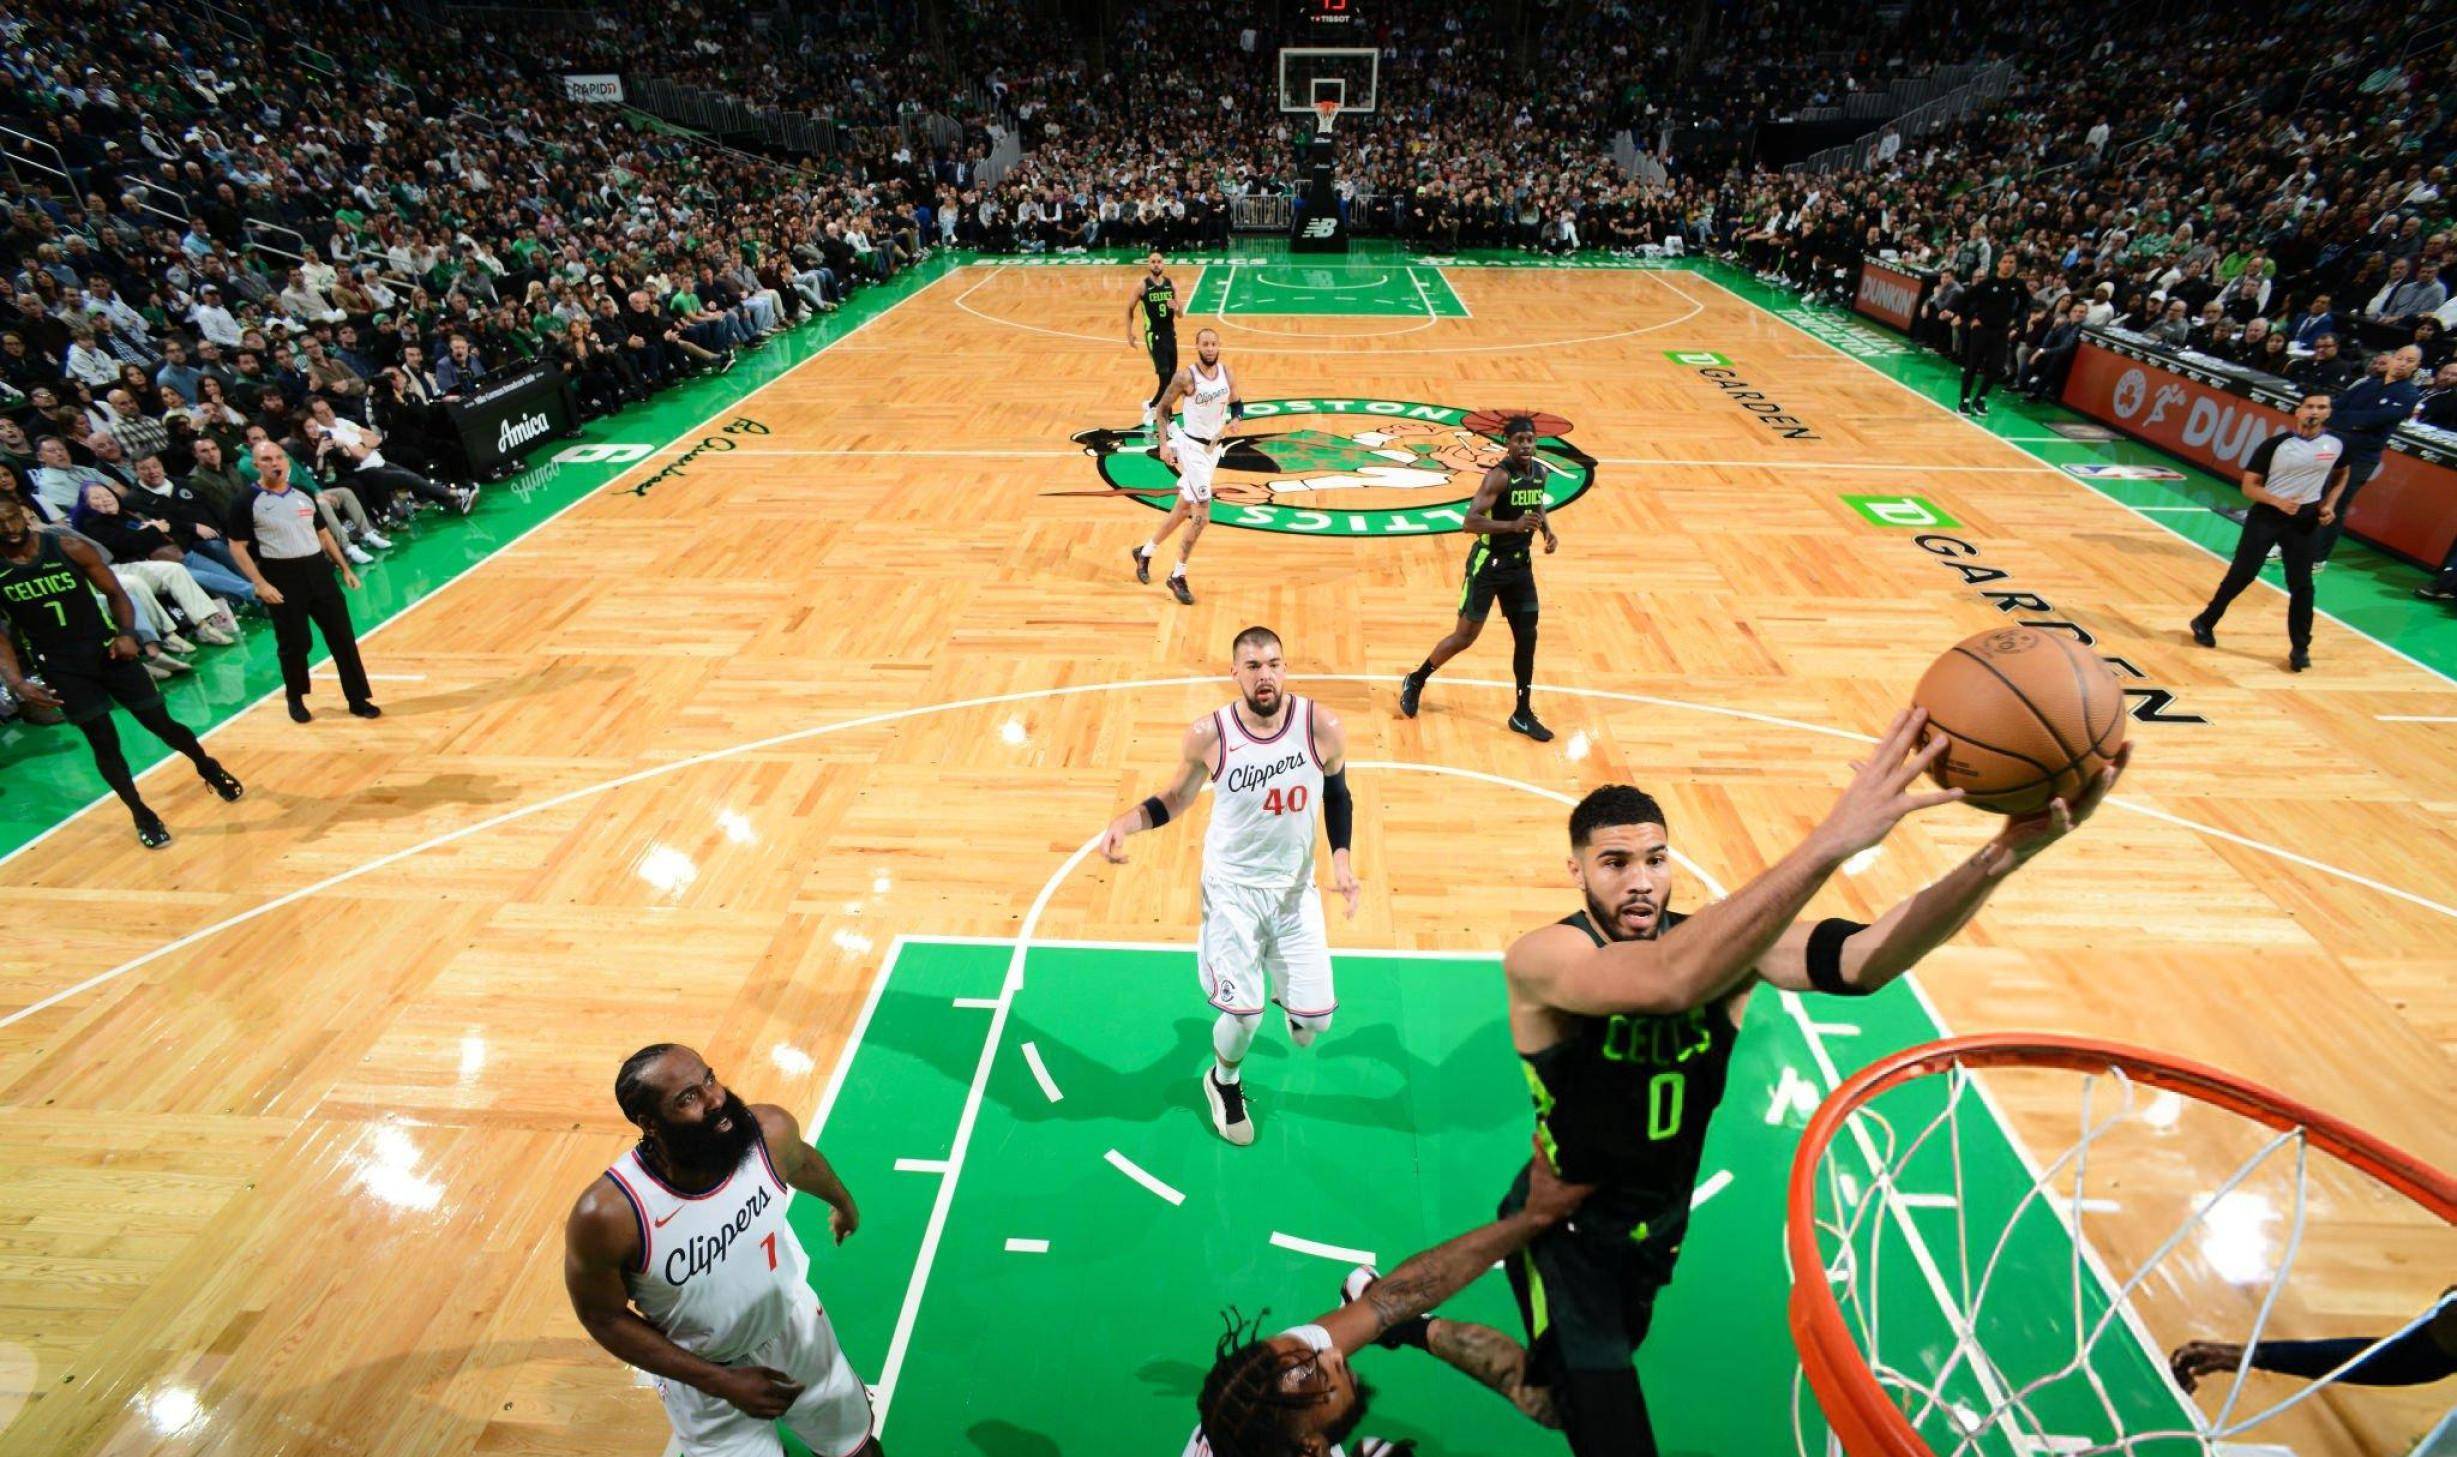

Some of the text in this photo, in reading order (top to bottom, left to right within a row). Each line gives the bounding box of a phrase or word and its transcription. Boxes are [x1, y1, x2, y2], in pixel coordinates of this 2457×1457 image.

[972, 257, 1119, 266] BOSTON
[1149, 291, 1173, 302] CELTICS
[1159, 303, 1167, 318] 9
[1699, 367, 1822, 440] GARDEN
[498, 412, 550, 453] Amica
[1511, 489, 1544, 506] CELTICS
[1858, 496, 1944, 527] TD
[3, 571, 77, 602] CELTICS
[43, 600, 67, 627] 7
[1228, 751, 1306, 793] Clippers
[1262, 785, 1308, 816] 40
[1648, 1071, 1685, 1141] 0
[665, 1185, 771, 1287] Clippers
[760, 1231, 777, 1272] 1
